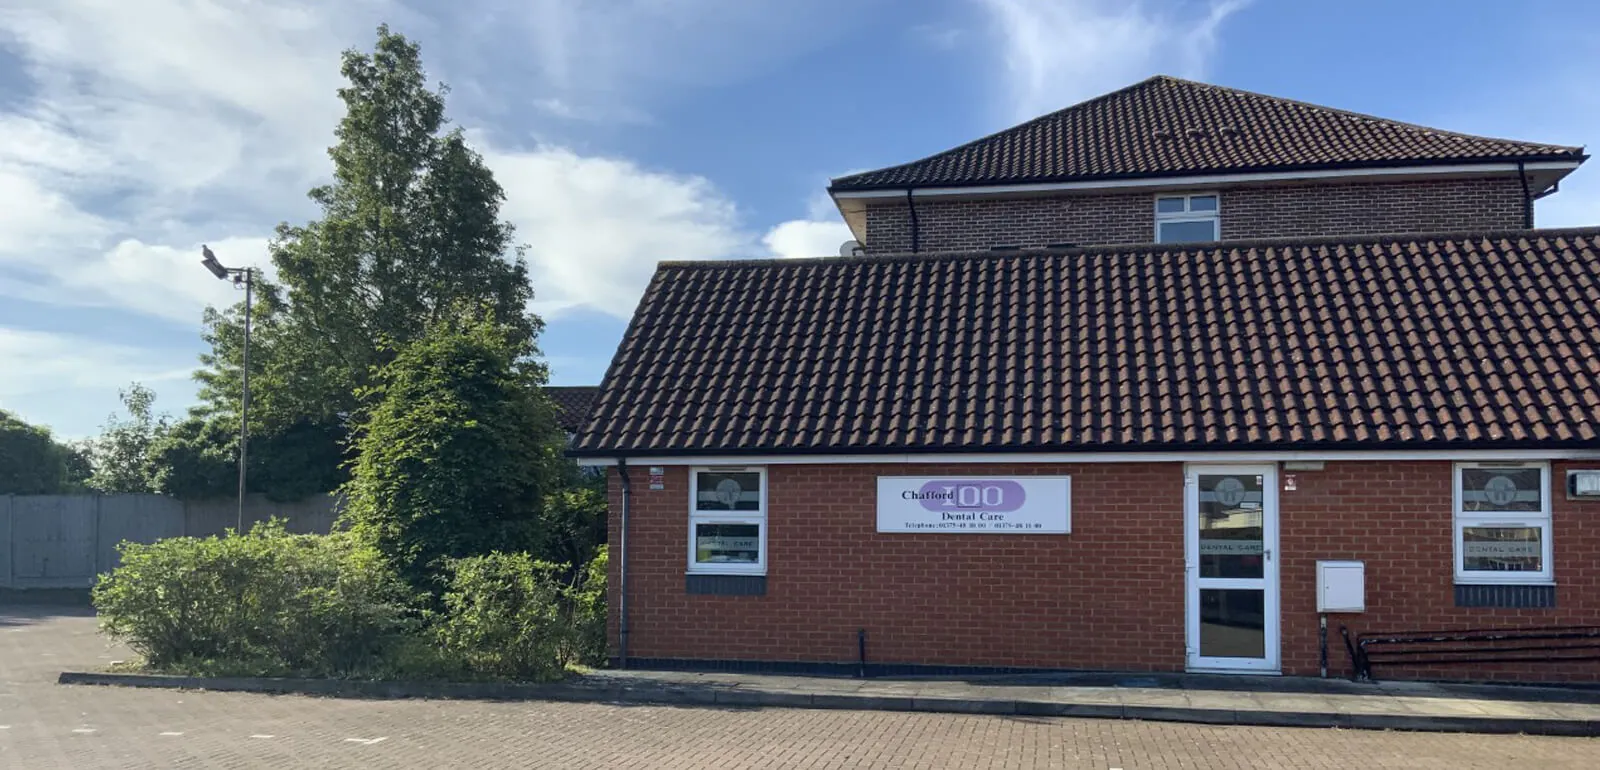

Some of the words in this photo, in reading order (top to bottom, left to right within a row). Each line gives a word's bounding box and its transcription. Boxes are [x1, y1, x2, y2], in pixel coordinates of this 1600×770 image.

[901, 490, 955, 500] Chafford
[942, 511, 976, 521] Dental
[980, 512, 1004, 521] Care
